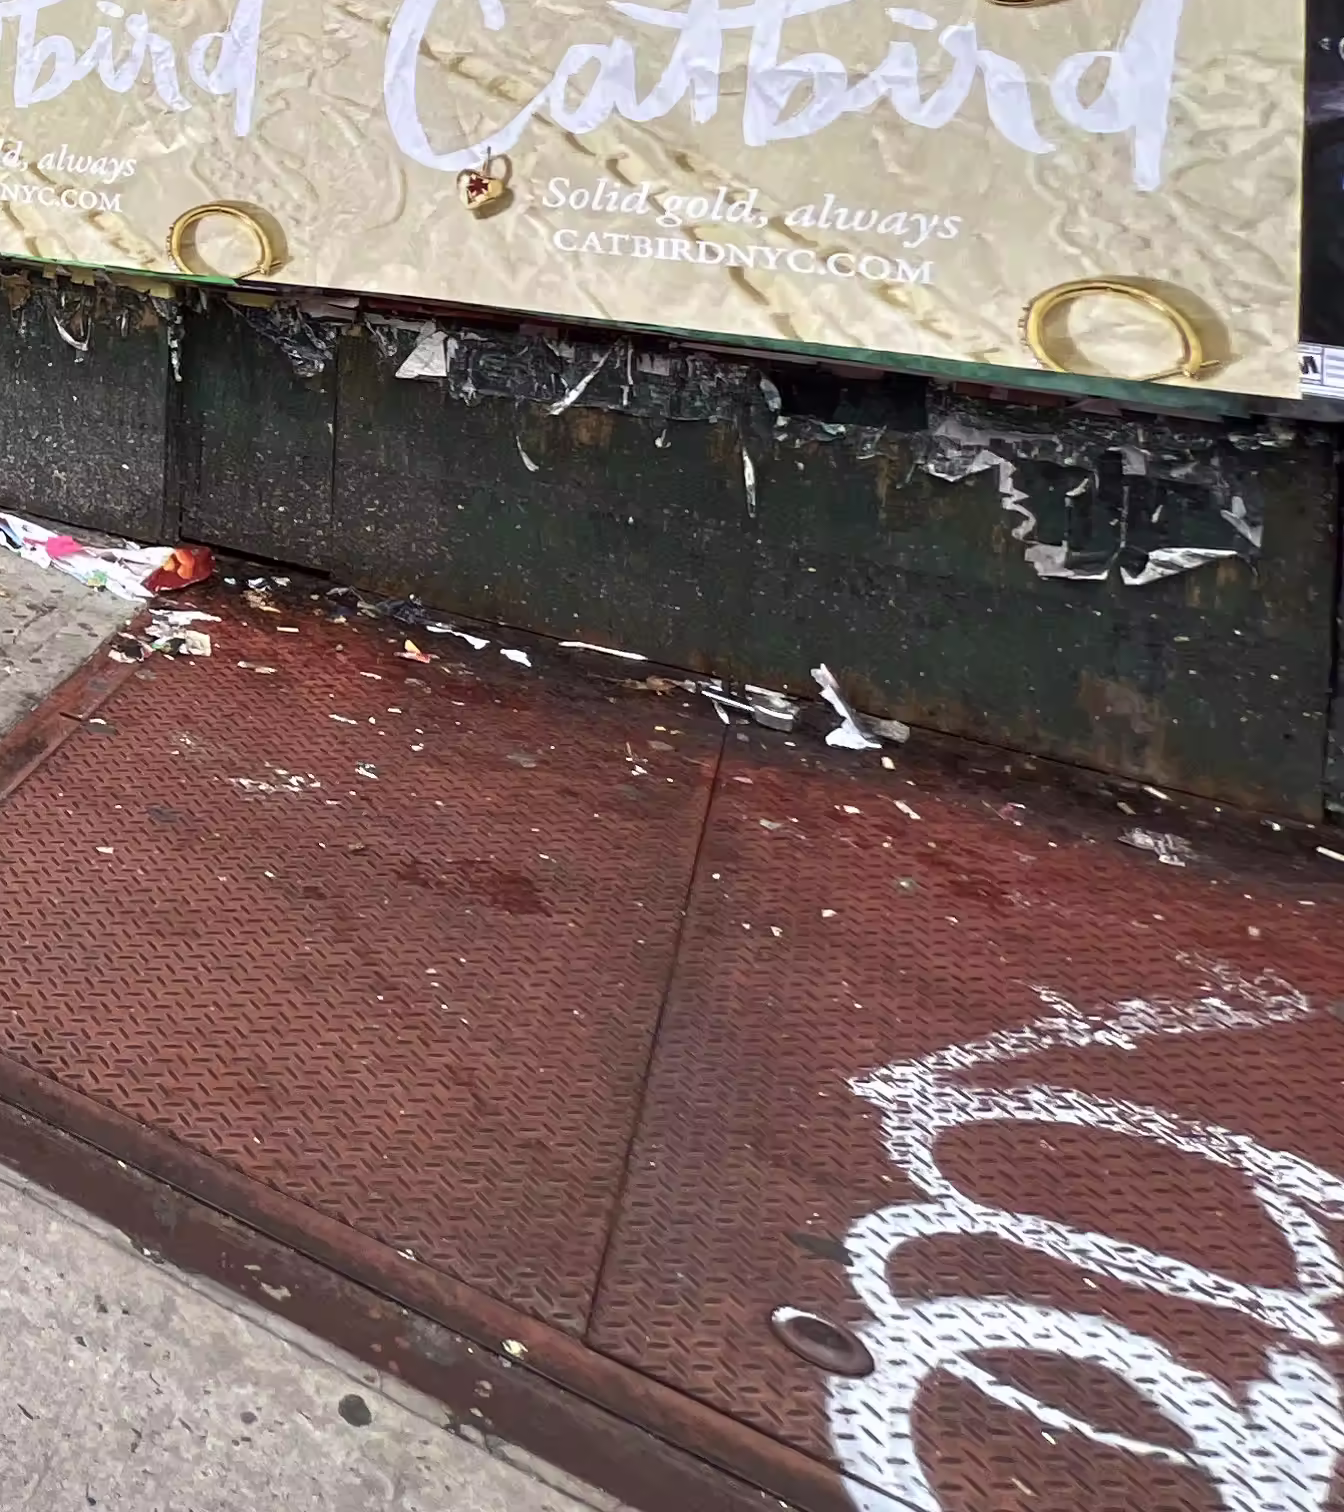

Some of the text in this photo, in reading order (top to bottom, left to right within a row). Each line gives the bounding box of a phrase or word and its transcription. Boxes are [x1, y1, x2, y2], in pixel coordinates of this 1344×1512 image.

[38, 145, 136, 185] always
[542, 174, 962, 245] Solid gold, always
[553, 227, 935, 286] CATBIRDNYC.COM
